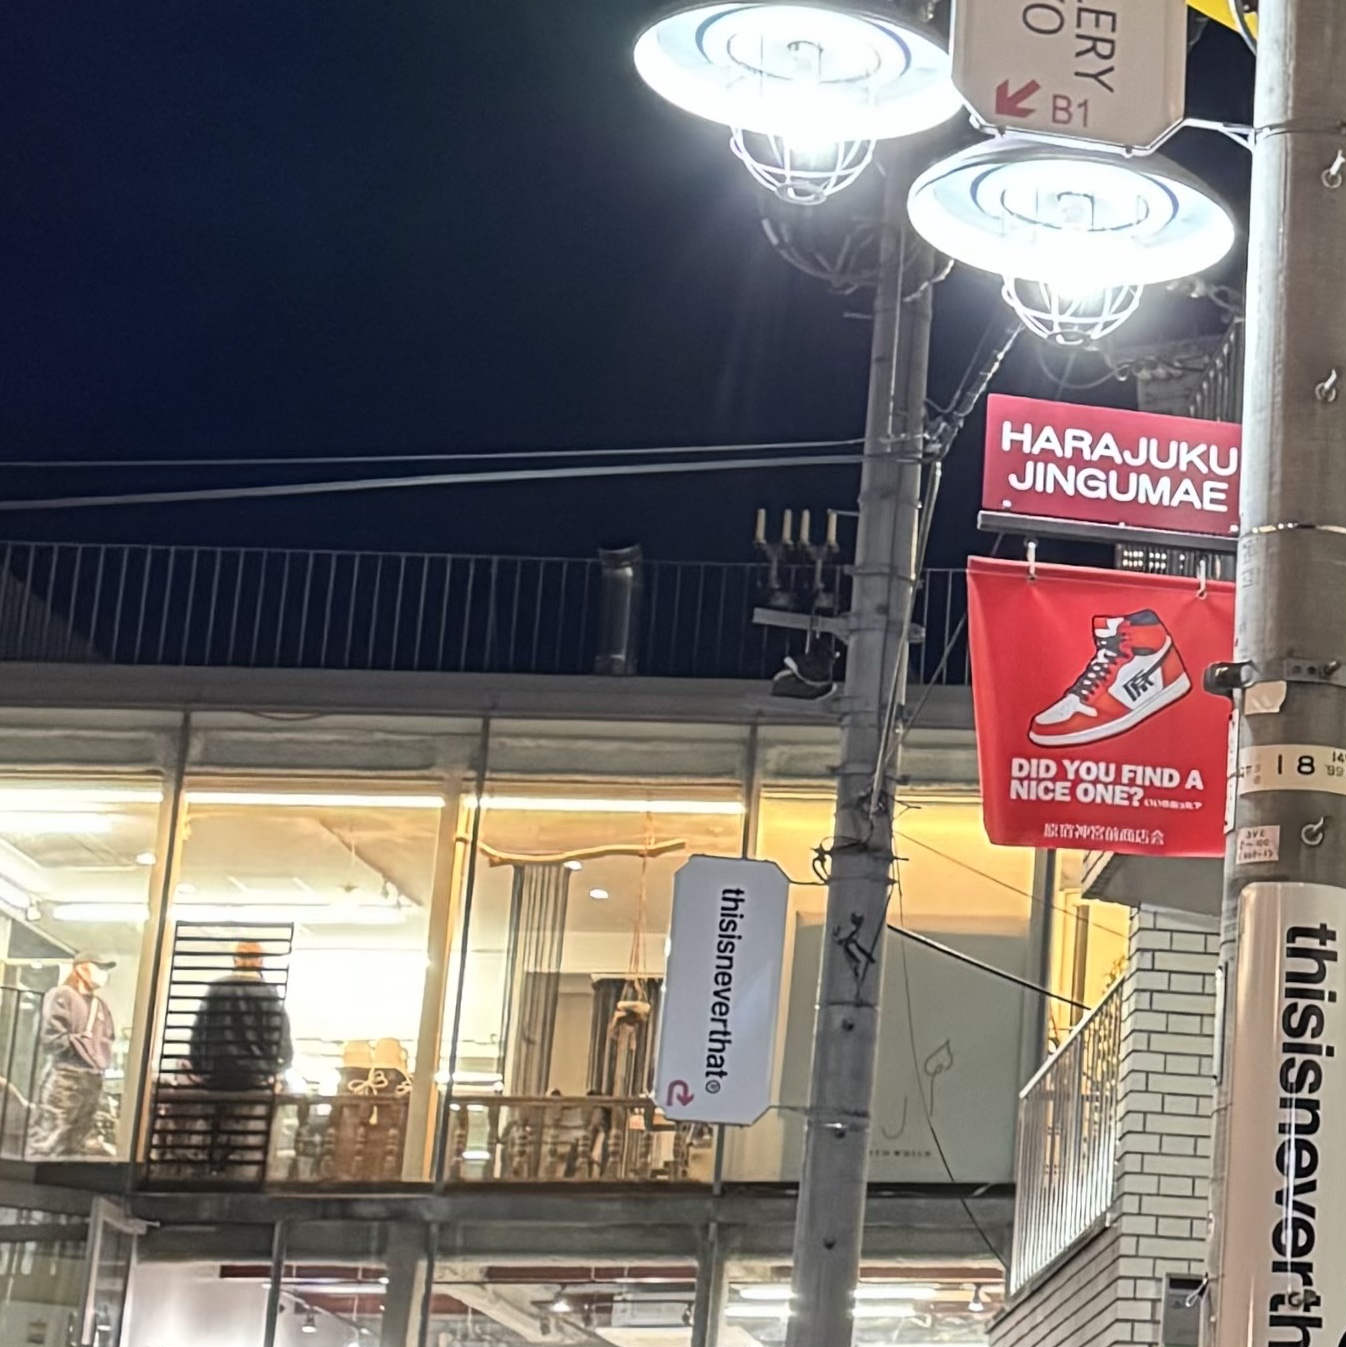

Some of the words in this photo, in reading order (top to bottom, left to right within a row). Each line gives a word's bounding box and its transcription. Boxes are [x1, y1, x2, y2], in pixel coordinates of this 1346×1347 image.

[1074, 0, 1117, 93] ERY
[1052, 94, 1088, 128] B1
[1001, 420, 1238, 476] HARAJUKU
[1008, 460, 1229, 512] JINGUMAE
[1010, 780, 1071, 801] NICE
[1076, 783, 1144, 807] ONE?
[1011, 758, 1057, 779] DID
[1062, 759, 1116, 783] YOU
[1121, 764, 1180, 788] FIND
[1185, 769, 1204, 790] A
